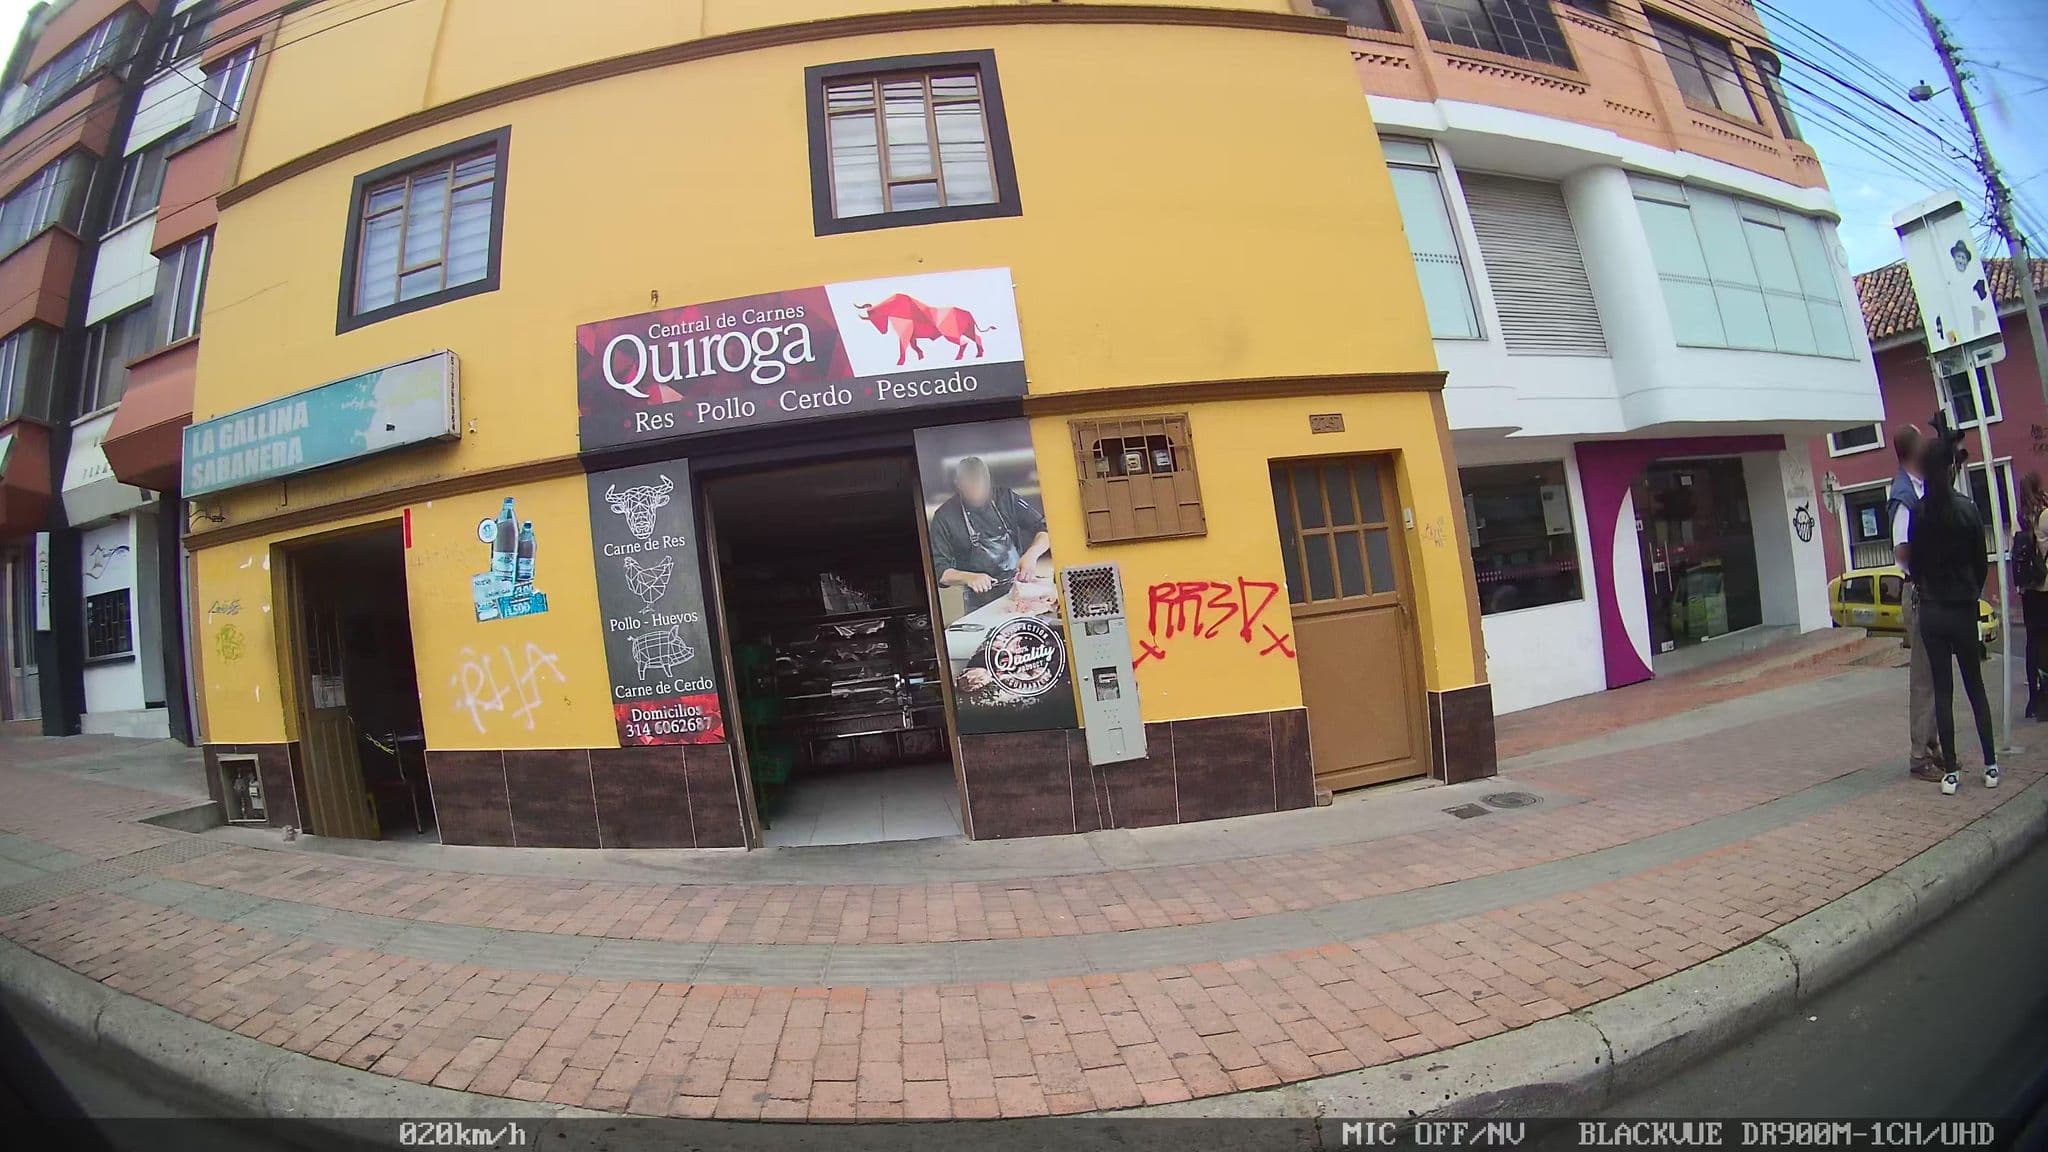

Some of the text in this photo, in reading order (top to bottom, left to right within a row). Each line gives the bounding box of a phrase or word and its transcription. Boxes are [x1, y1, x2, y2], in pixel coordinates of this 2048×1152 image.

[648, 305, 805, 340] Central de Carnes
[602, 322, 816, 399] Quiroga
[635, 370, 978, 433] Res Pollo Cerdo Pescado
[192, 400, 310, 458] LA GALLINA
[603, 535, 686, 558] Carne de Res
[610, 617, 642, 632] Pollo
[652, 611, 698, 627] Huevos
[994, 644, 1056, 672] Quality
[615, 676, 714, 699] Carne de Cerdo
[631, 703, 704, 722] Domicilios
[626, 716, 713, 738] 314 6062687
